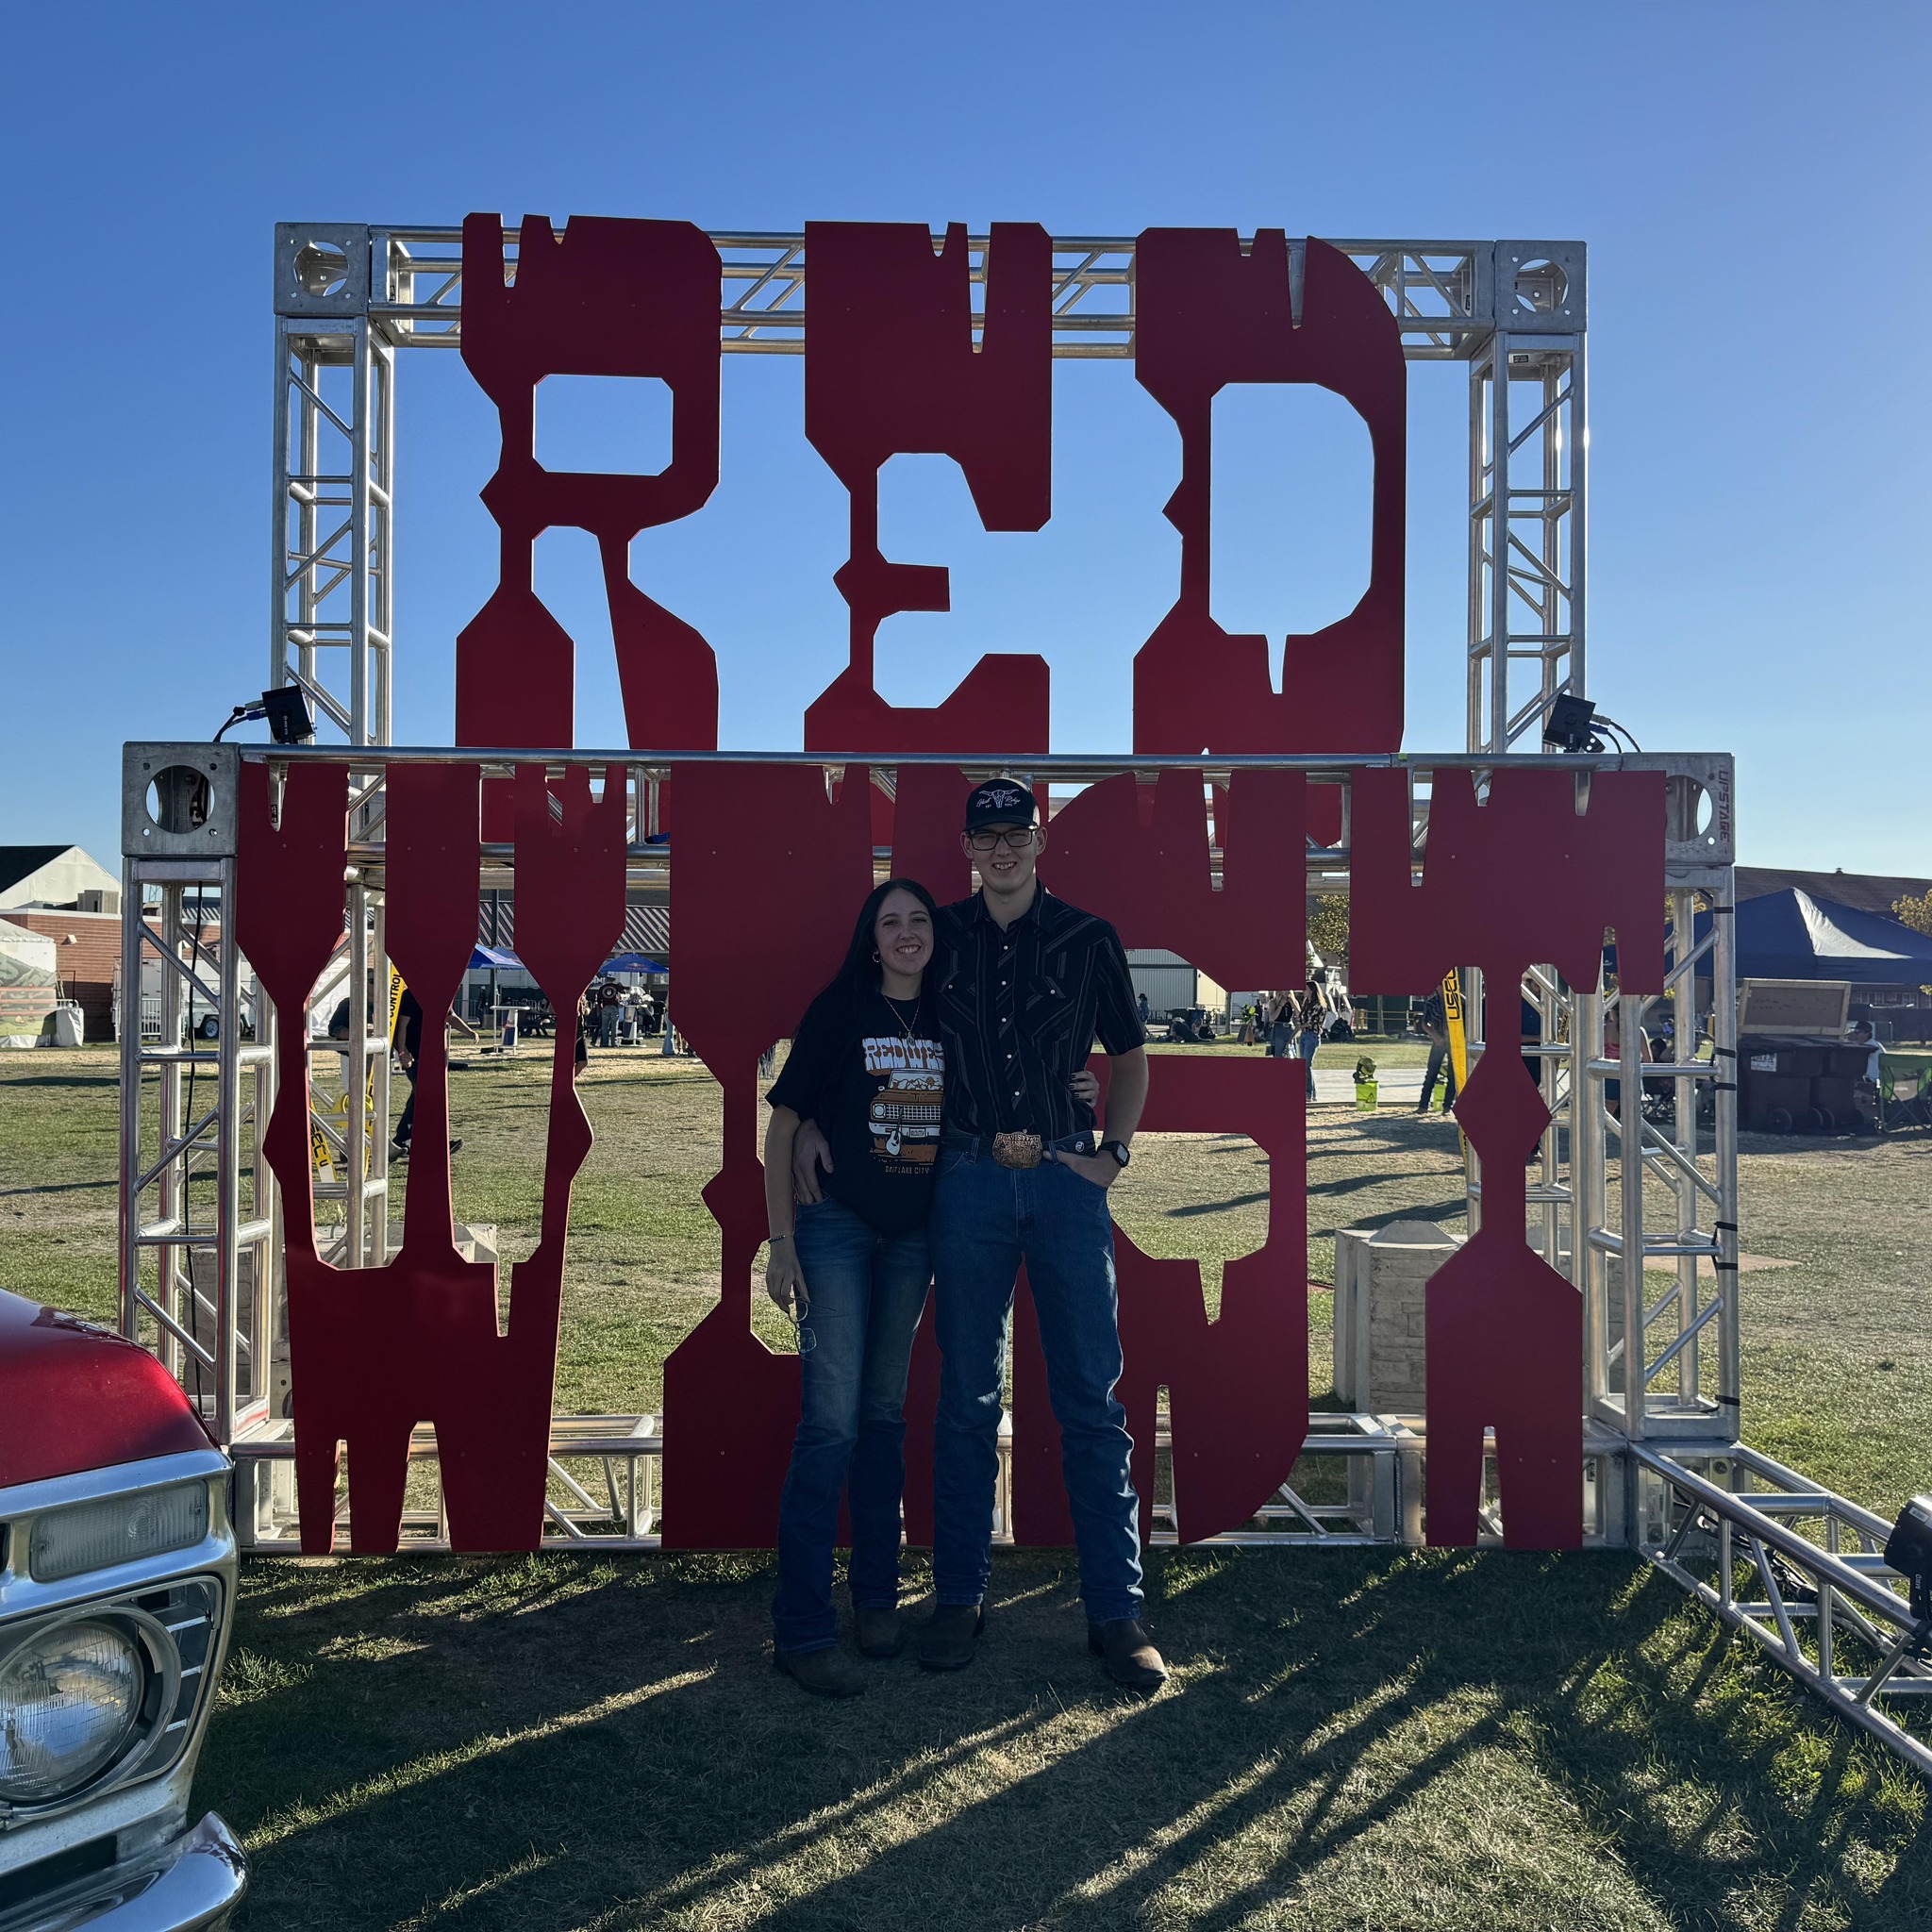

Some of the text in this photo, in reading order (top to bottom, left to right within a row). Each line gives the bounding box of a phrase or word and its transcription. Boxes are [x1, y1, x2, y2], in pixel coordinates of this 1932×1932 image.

[455, 212, 1407, 755] RED
[1718, 770, 1730, 842] UPSTAGE
[914, 1166, 930, 1174] CITY
